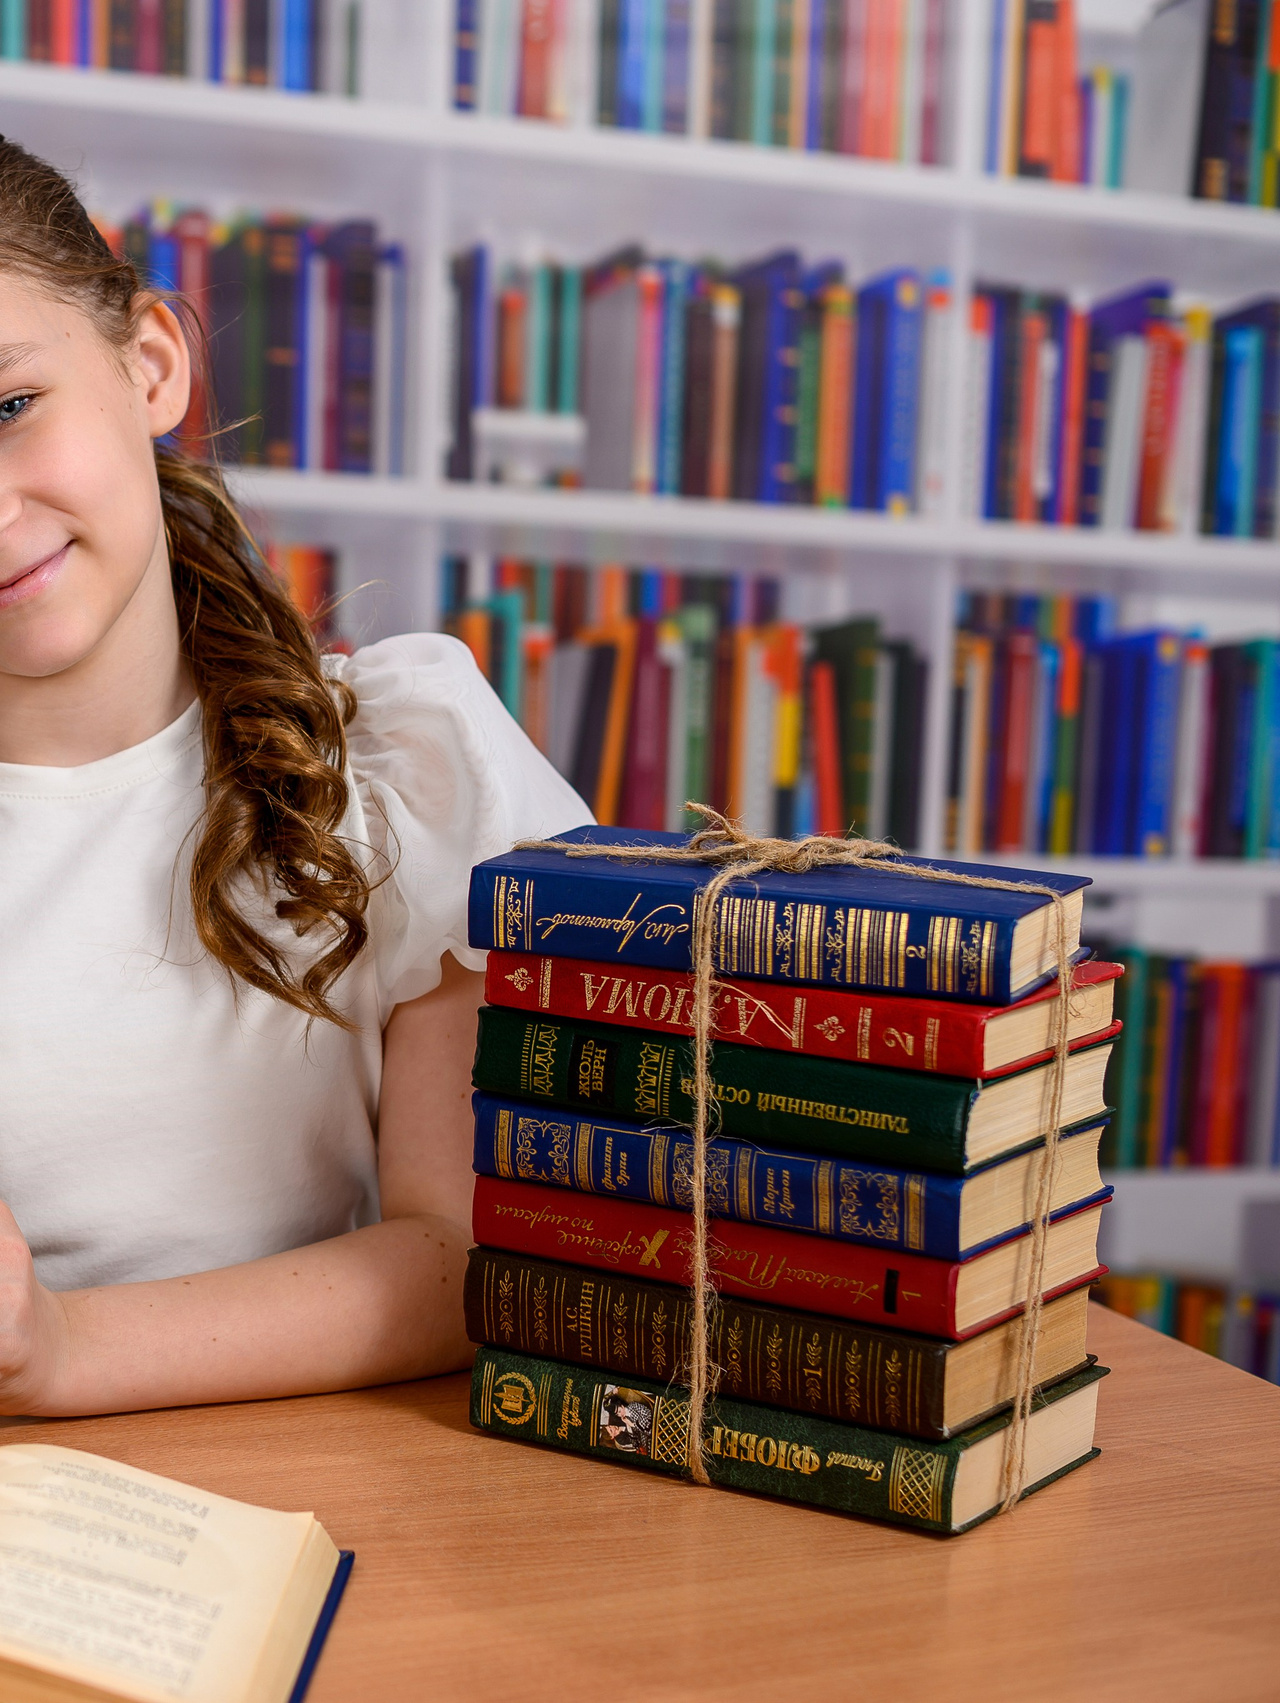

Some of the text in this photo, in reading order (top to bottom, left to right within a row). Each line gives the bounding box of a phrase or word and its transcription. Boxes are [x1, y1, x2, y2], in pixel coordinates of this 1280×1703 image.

[536, 892, 686, 953] Лермонтов
[904, 945, 927, 960] 2
[882, 1027, 915, 1057] 2
[578, 1039, 595, 1098] ЖЮЛЬ
[592, 1046, 608, 1093] ВЕРН
[757, 1091, 911, 1135] ТАИНСТВЕННЫЙ
[763, 1167, 780, 1214] Морис
[494, 1203, 595, 1232] по мукам
[556, 1228, 670, 1270] Хождение
[783, 1266, 880, 1305] Алексей
[579, 1280, 595, 1358] ПУШКИН
[802, 1367, 823, 1379] 1
[825, 1450, 886, 1482] Гюстав
